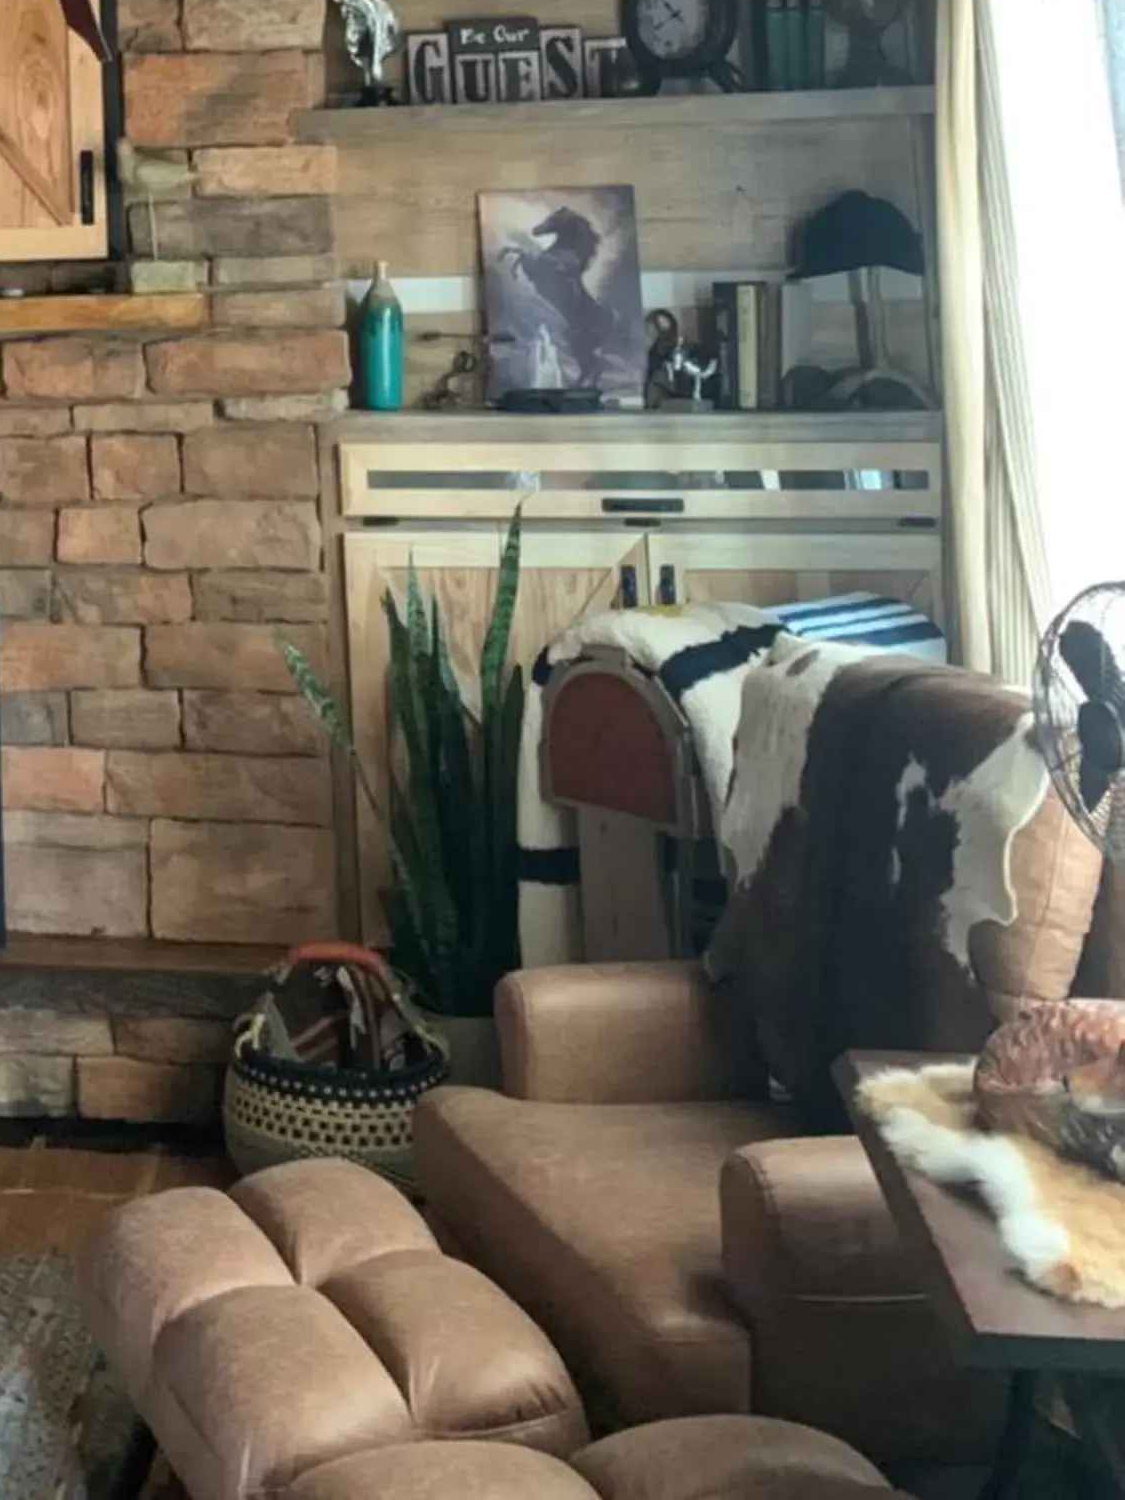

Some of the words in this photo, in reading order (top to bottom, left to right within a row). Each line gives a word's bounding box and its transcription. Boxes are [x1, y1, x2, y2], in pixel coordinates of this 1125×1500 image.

[459, 28, 487, 46] Be
[492, 24, 531, 43] Our
[414, 37, 626, 103] GUEST
